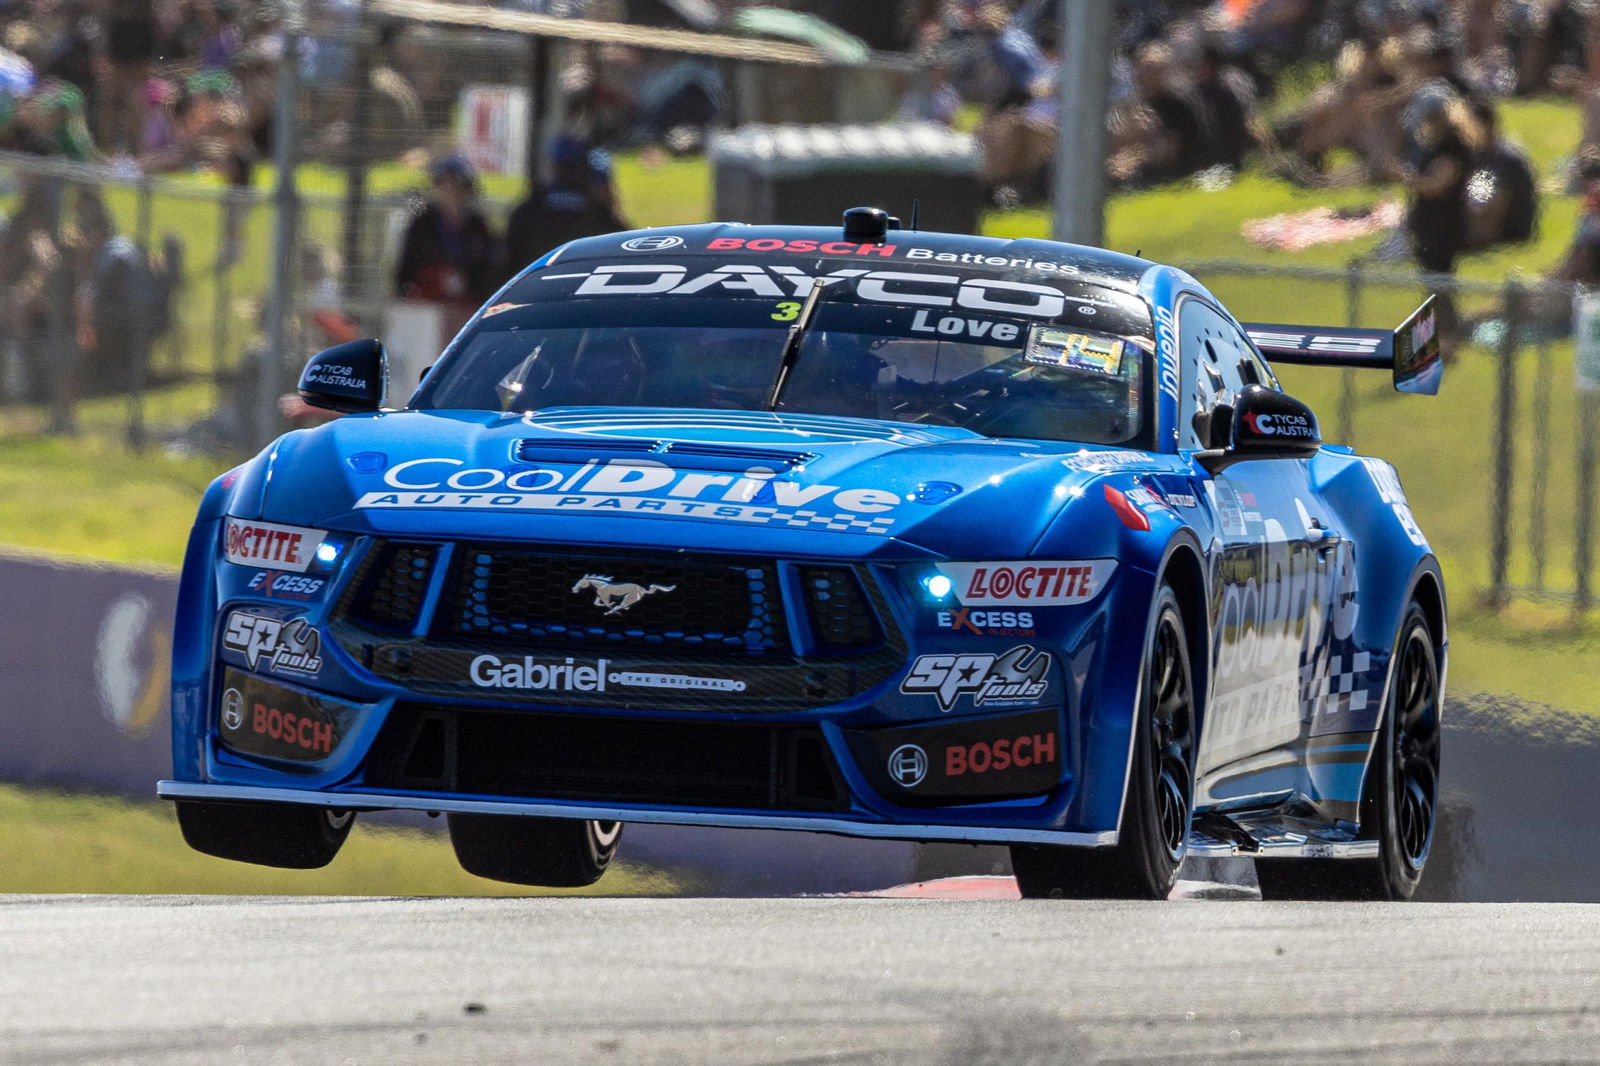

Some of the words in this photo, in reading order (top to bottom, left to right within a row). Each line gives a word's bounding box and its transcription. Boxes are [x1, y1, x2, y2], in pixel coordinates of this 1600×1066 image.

[705, 237, 898, 257] BOSCH
[905, 248, 1080, 275] Batteries
[574, 264, 1066, 318] DAYCO
[770, 301, 802, 321] 3
[910, 310, 1019, 341] Love
[315, 375, 367, 389] AUSTRALIA
[321, 364, 353, 376] TYCAB
[1271, 413, 1308, 426] TYCAB
[384, 457, 901, 513] CoolDrive
[369, 494, 524, 506] AUTO
[555, 496, 746, 519] PARTS
[965, 565, 1093, 600] LOCTITE
[937, 608, 1035, 635] EXCESS
[223, 612, 283, 669] SP
[271, 642, 322, 672] tools
[469, 654, 607, 692] Gabriel
[627, 675, 651, 683] THE
[660, 677, 727, 688] ORIGINAL
[902, 654, 998, 711] SP
[976, 674, 1047, 704] tools
[252, 703, 333, 753] BOSCH
[945, 732, 1055, 776] BOSCH
